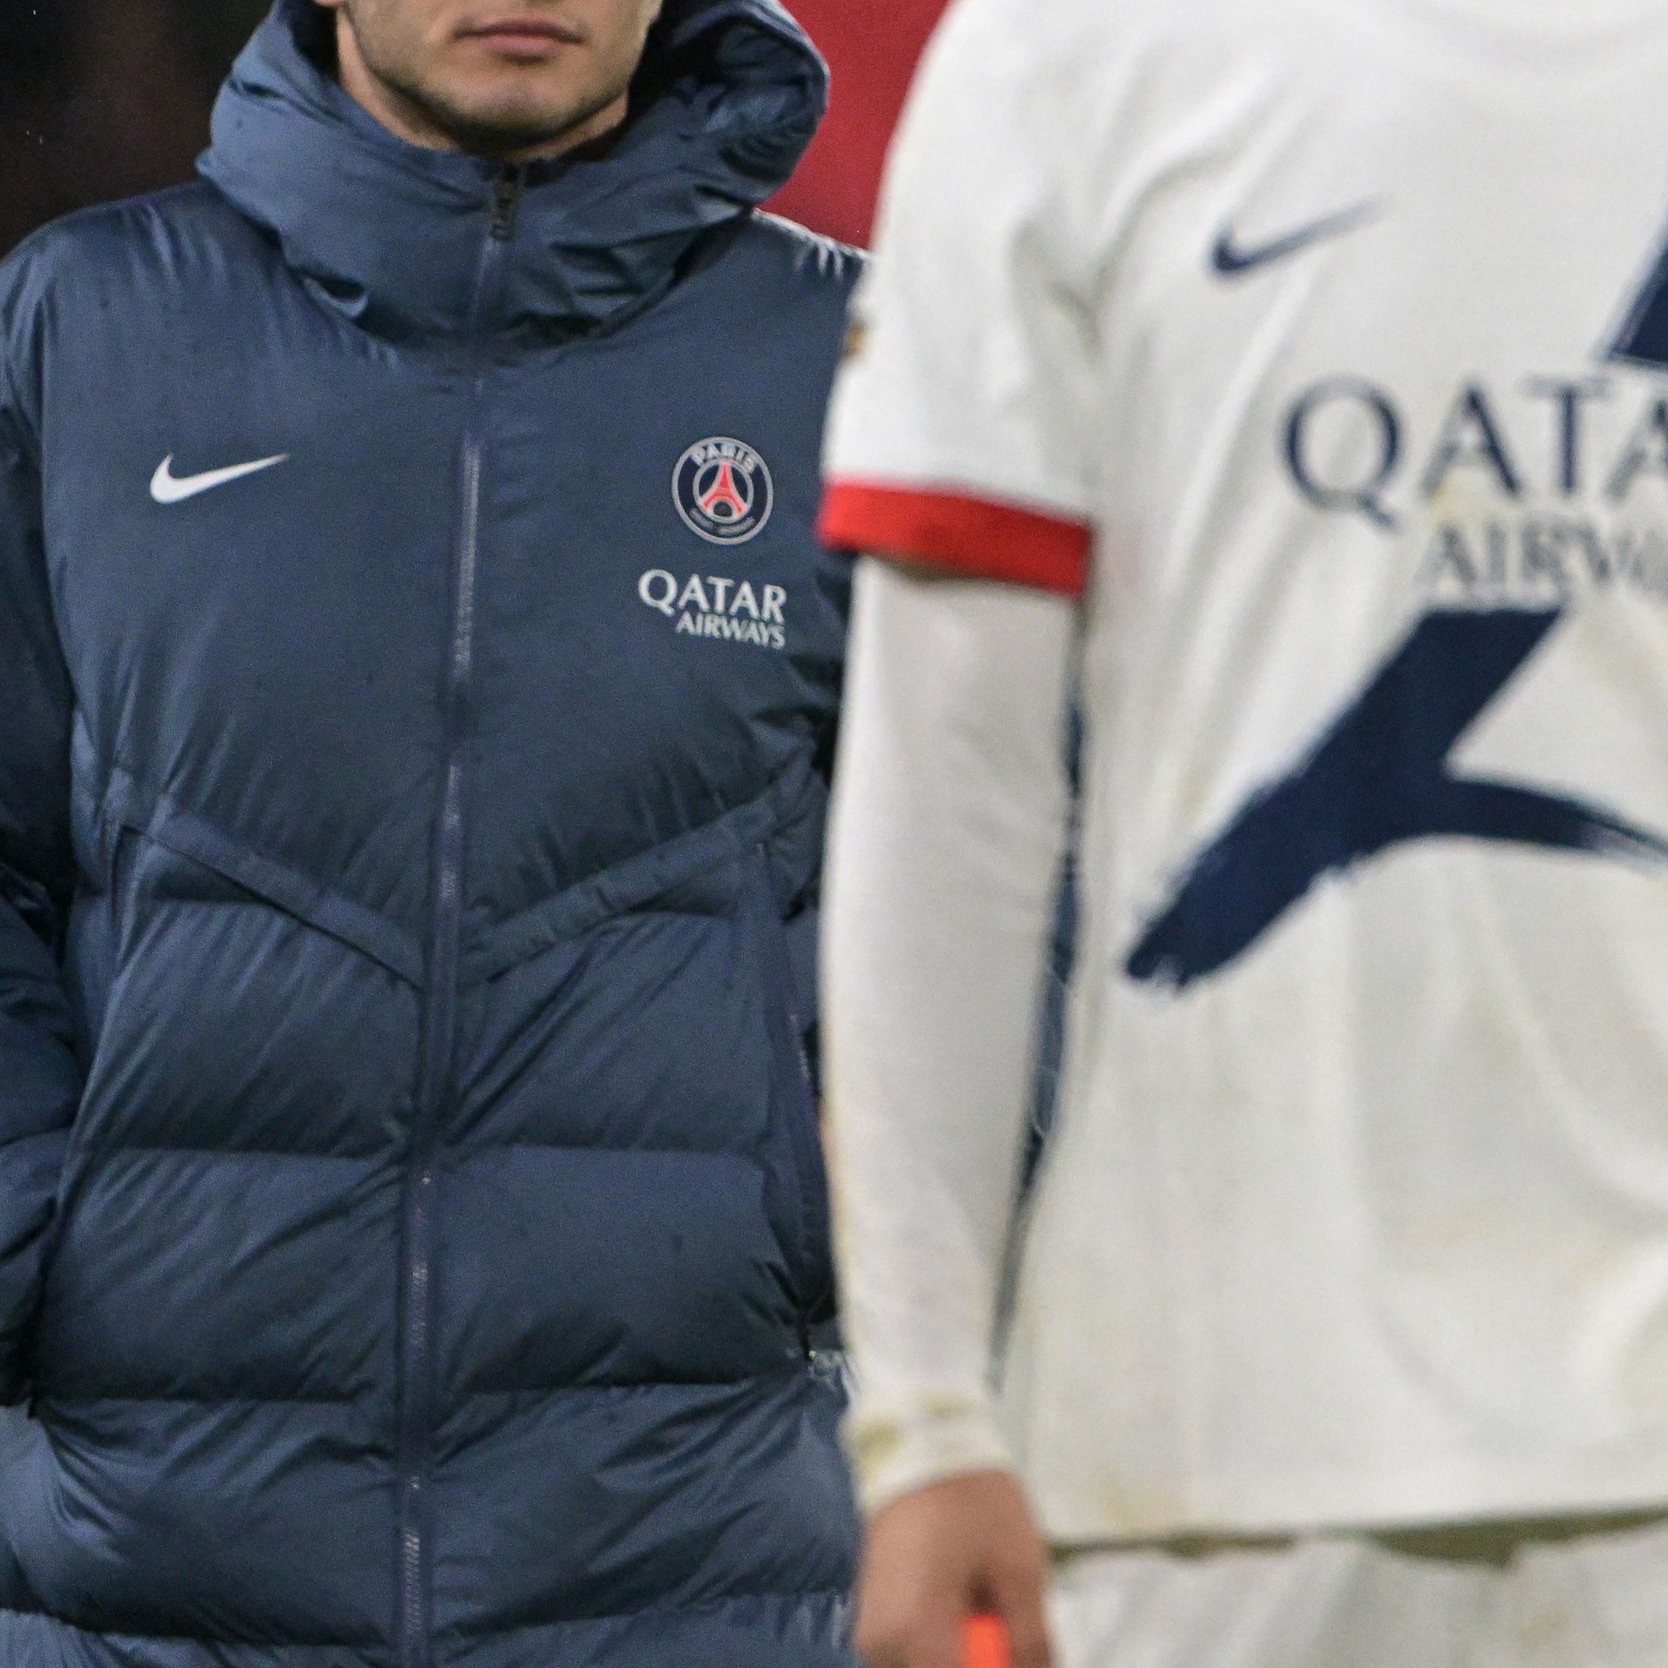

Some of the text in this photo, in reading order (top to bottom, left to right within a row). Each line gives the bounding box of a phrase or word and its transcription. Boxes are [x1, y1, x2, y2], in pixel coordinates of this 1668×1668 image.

[690, 442, 758, 474] PARIS
[637, 568, 788, 624] QATAR
[674, 611, 786, 650] AIRWAYS
